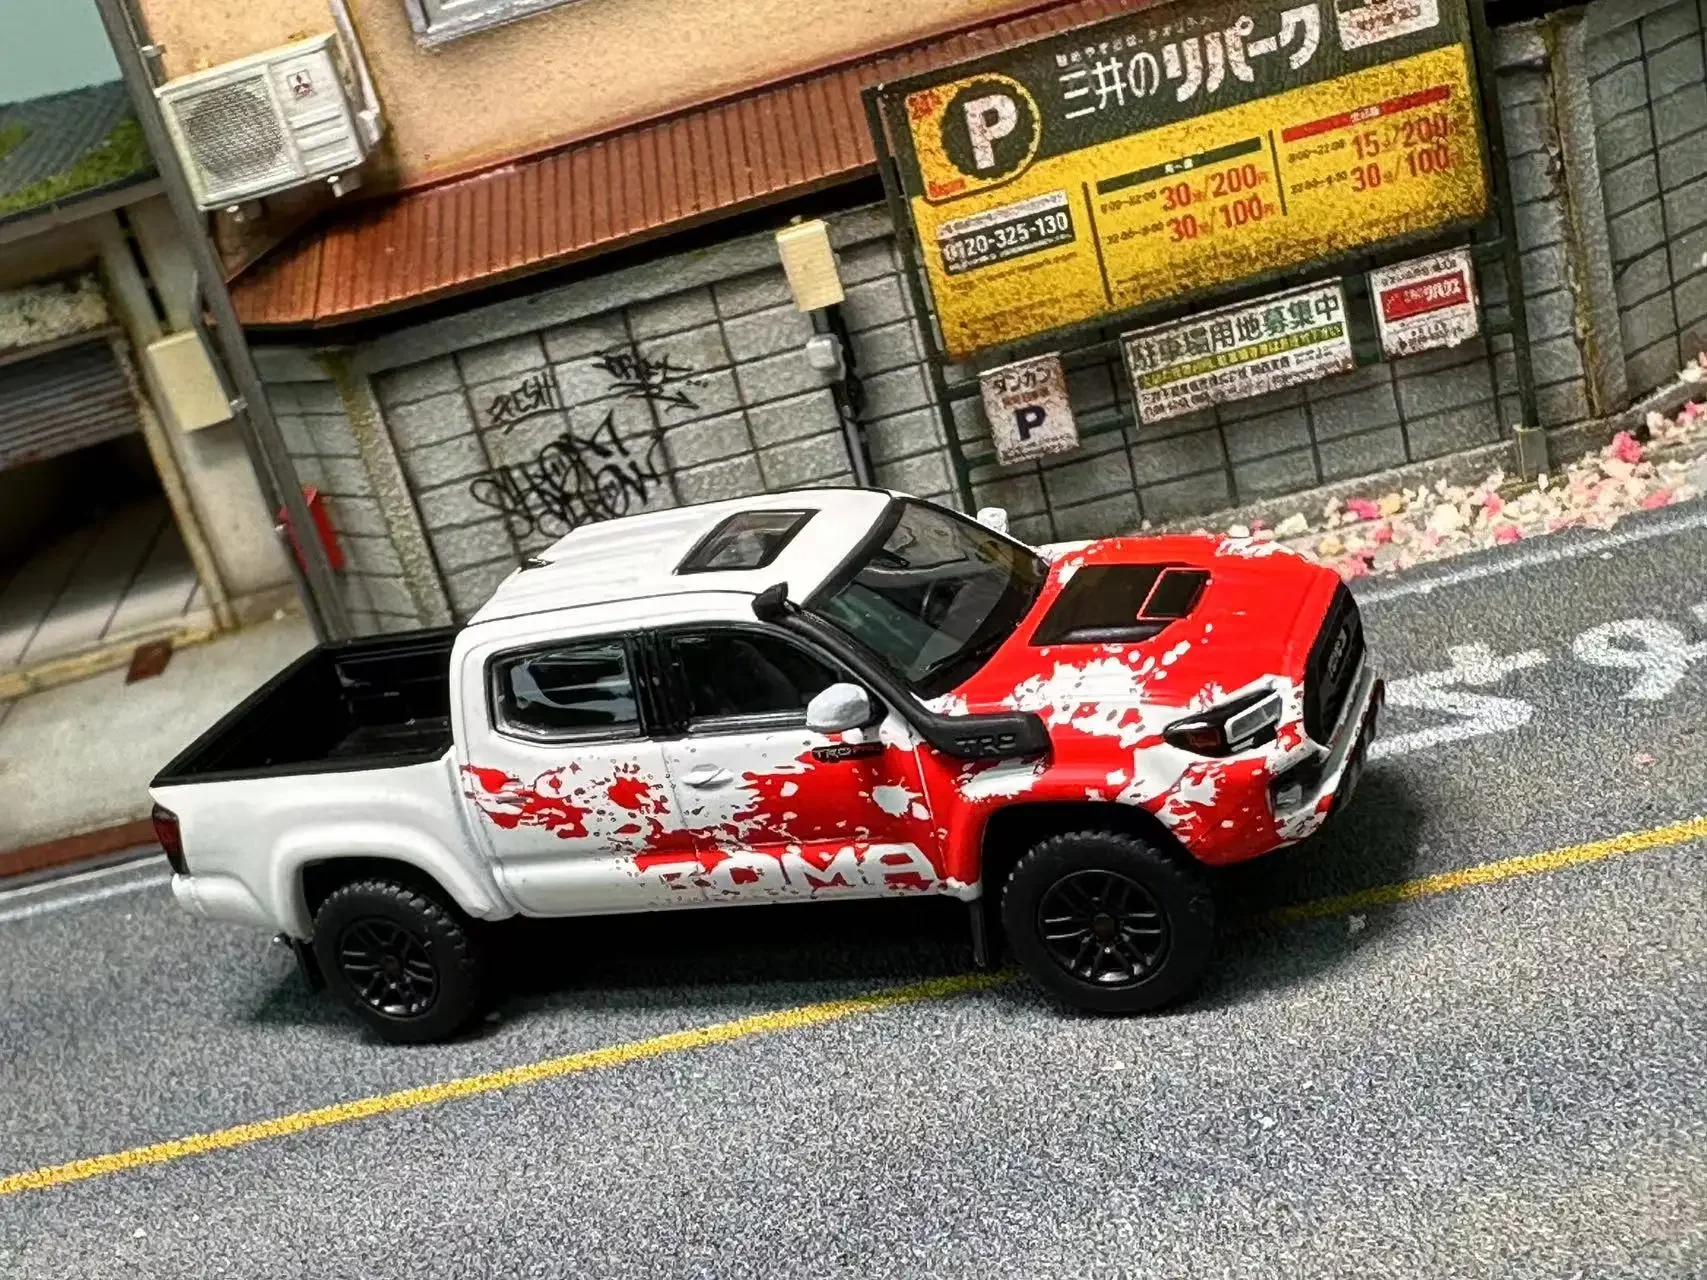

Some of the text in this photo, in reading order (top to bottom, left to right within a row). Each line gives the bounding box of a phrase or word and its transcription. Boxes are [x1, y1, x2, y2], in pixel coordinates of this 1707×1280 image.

[1059, 3, 1320, 119] 三井のリパーク
[963, 94, 1018, 169] P
[942, 211, 1068, 263] 0120-325-130
[1015, 405, 1047, 441] P
